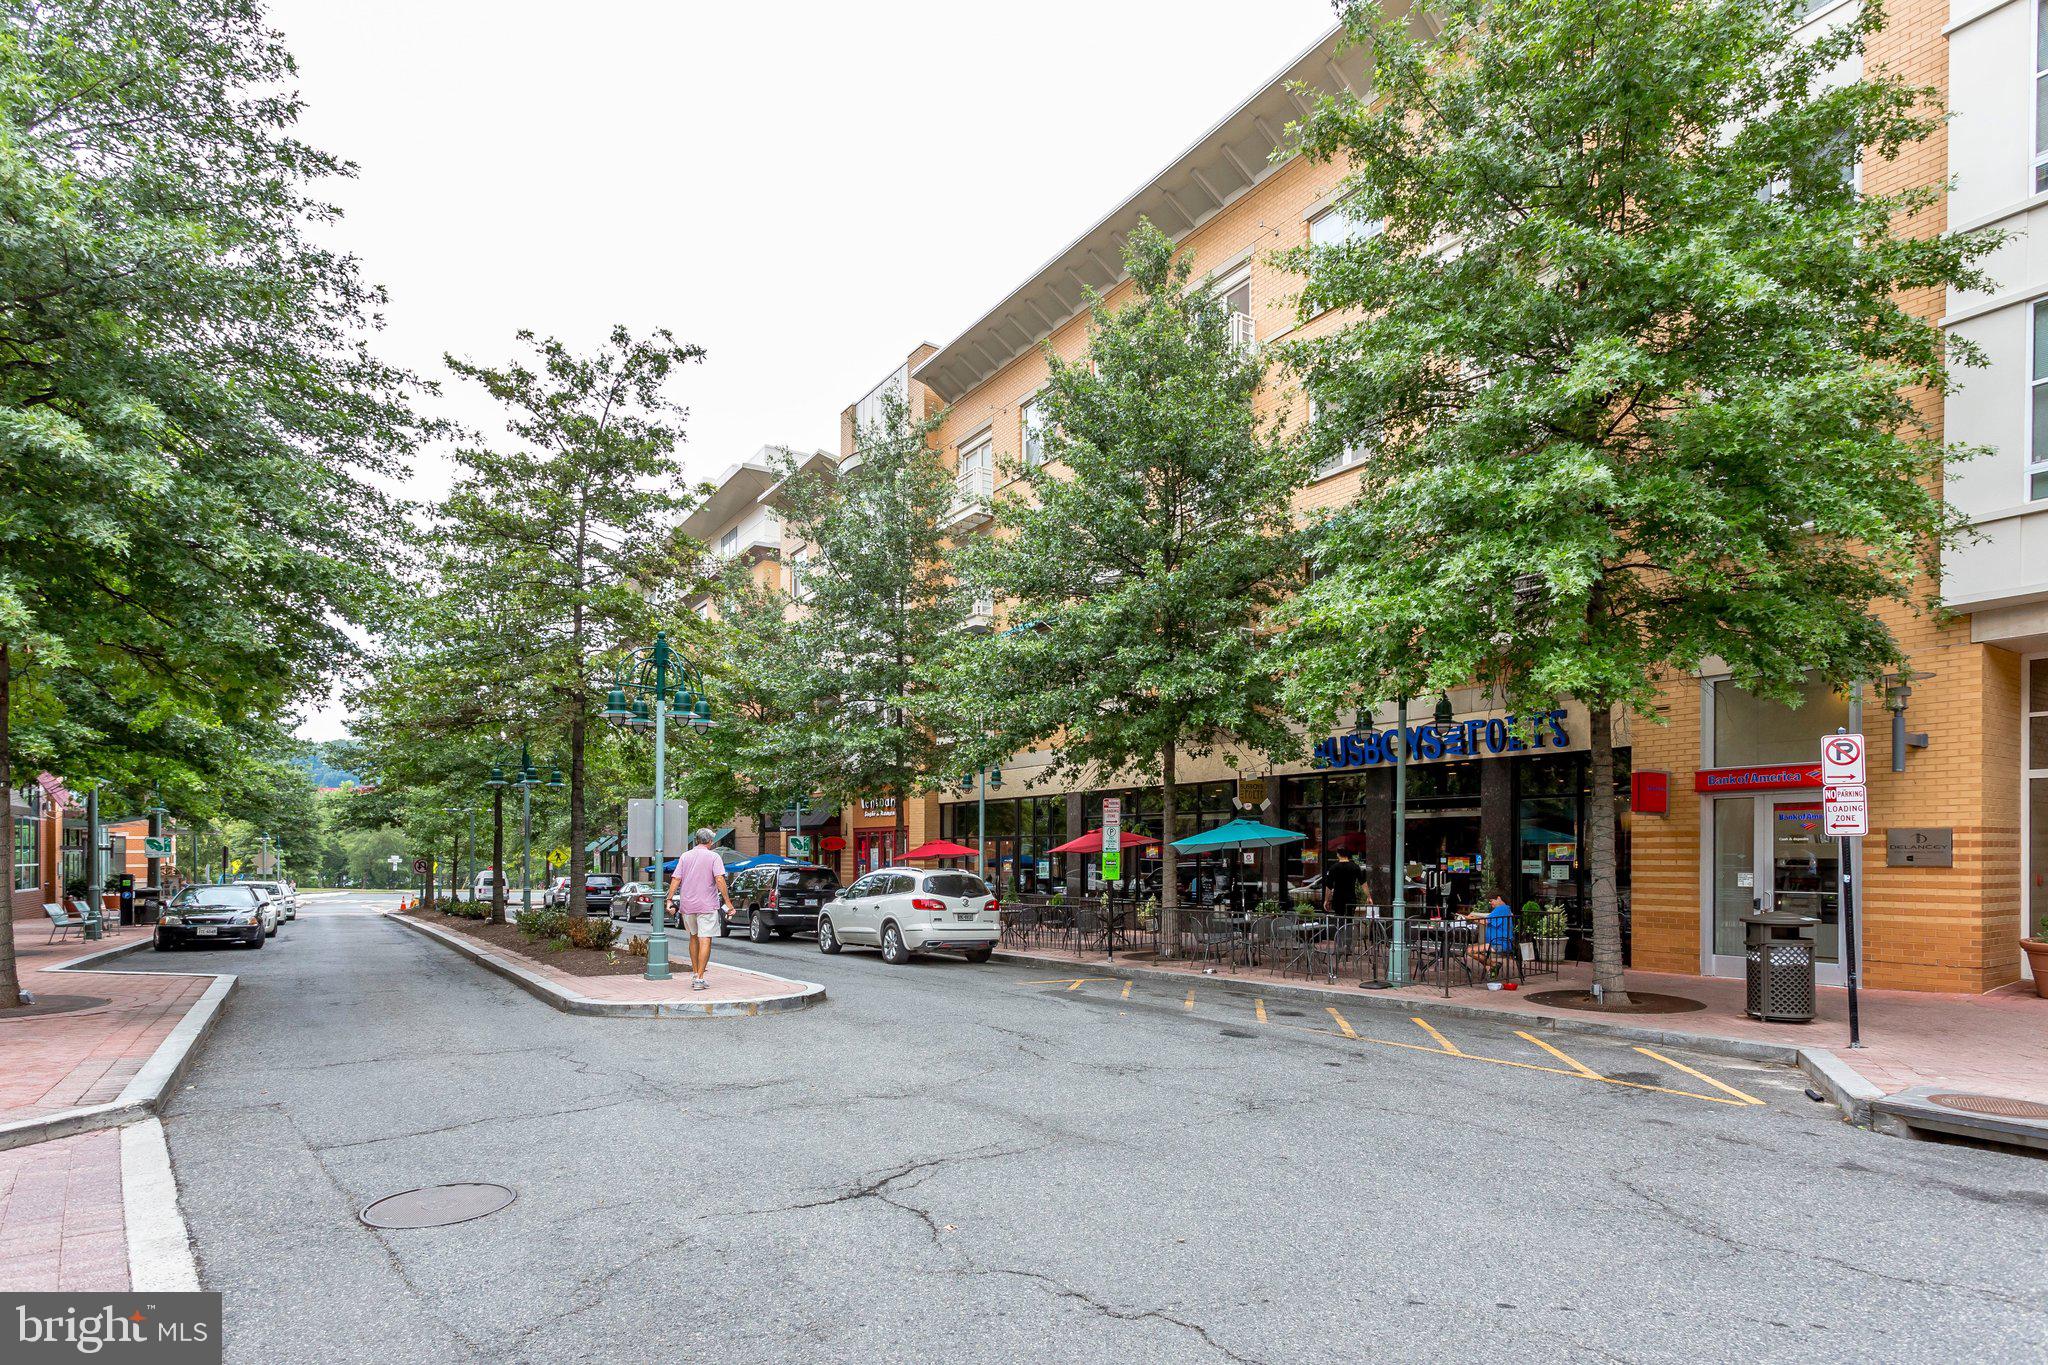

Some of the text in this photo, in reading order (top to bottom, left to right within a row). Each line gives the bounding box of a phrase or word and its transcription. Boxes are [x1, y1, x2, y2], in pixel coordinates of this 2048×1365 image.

[1707, 771, 1801, 785] Bank of America
[1825, 790, 1863, 800] NO PARKING
[1827, 805, 1863, 813] LOADING
[1779, 813, 1798, 821] Bank
